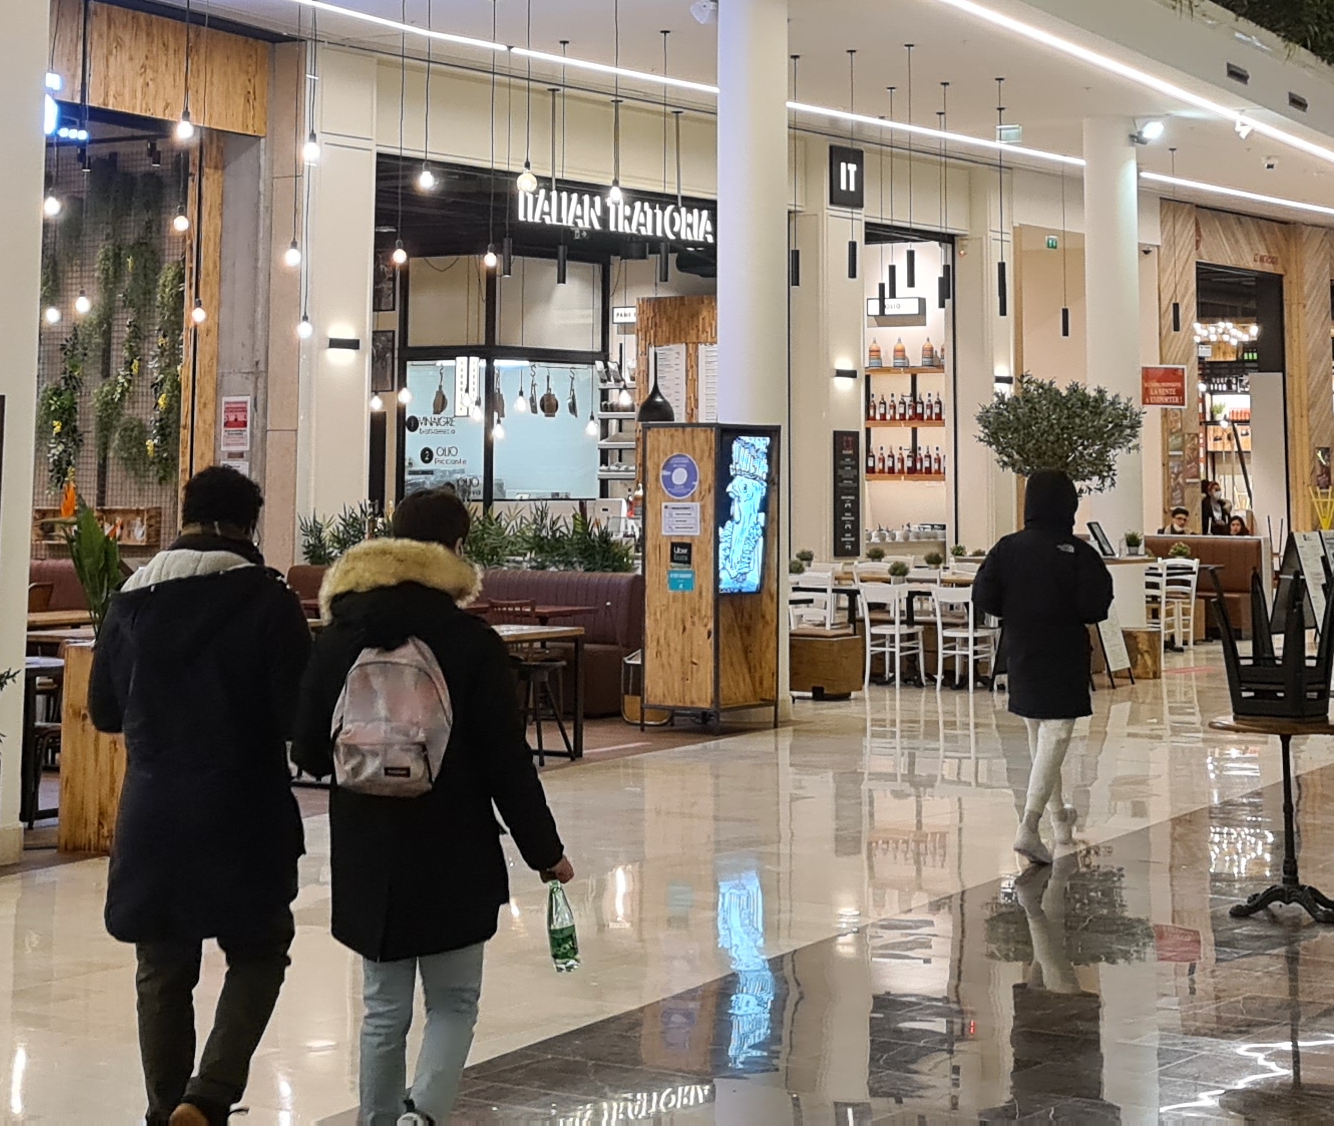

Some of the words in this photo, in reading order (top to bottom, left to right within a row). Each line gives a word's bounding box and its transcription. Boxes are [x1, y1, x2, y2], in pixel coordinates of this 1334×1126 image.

[840, 161, 857, 192] IT
[517, 188, 602, 230] ITALIAN
[605, 195, 715, 244] TRATTORIA
